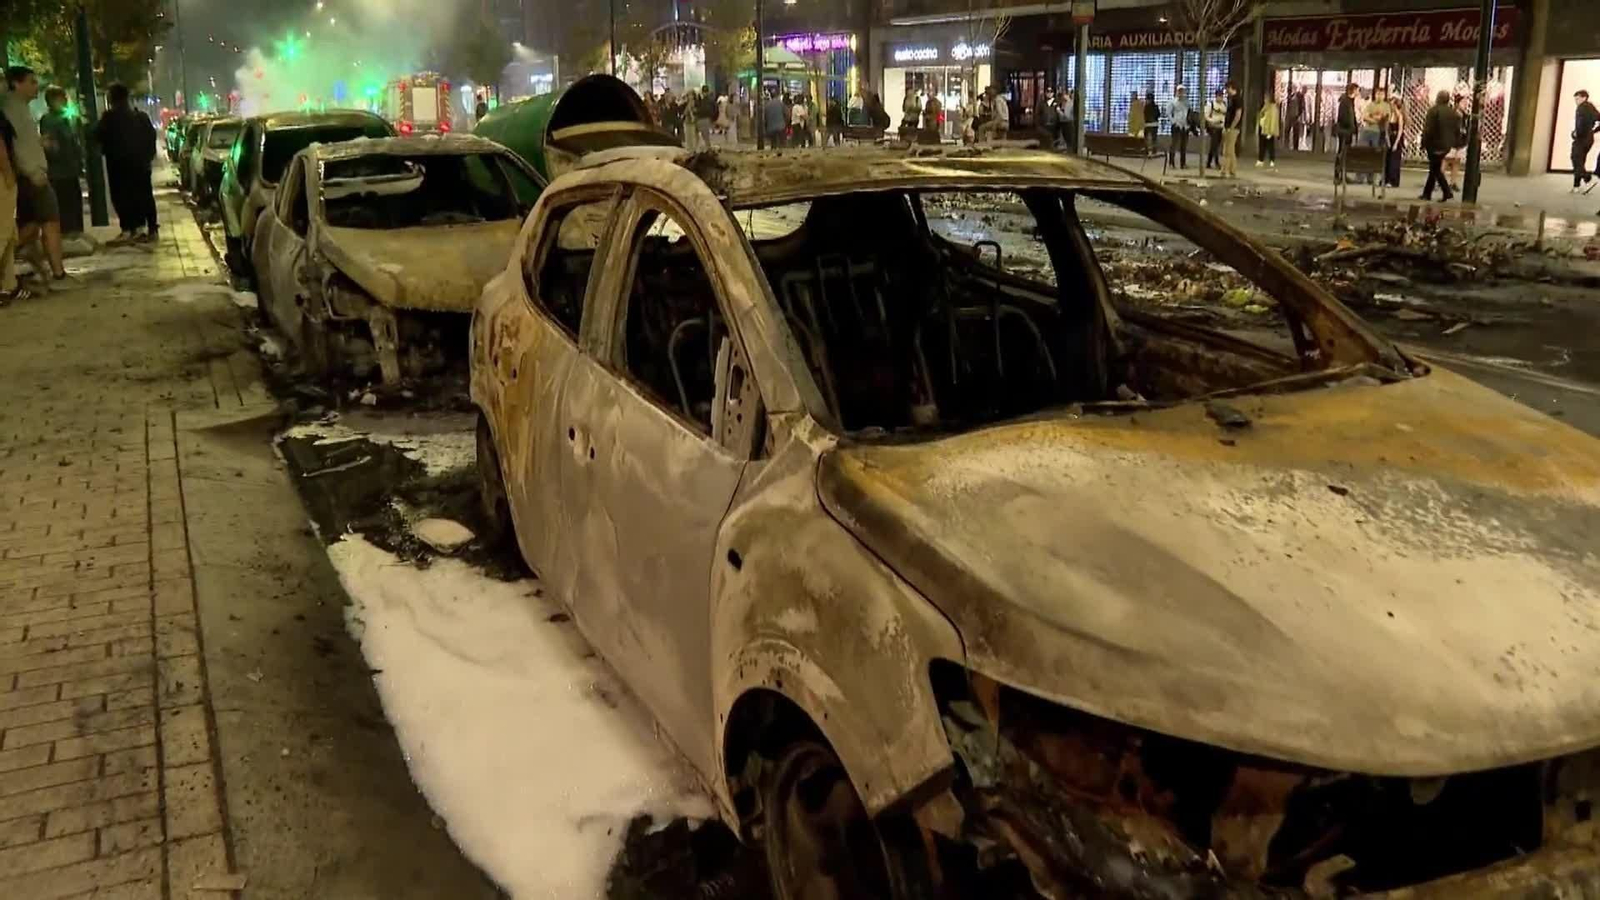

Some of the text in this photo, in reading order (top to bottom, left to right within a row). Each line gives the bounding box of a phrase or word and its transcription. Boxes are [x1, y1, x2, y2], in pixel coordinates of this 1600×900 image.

[1086, 32, 1202, 48] ARIA AUXILIADO
[1266, 26, 1319, 47] Modas
[1440, 18, 1511, 41] Mos
